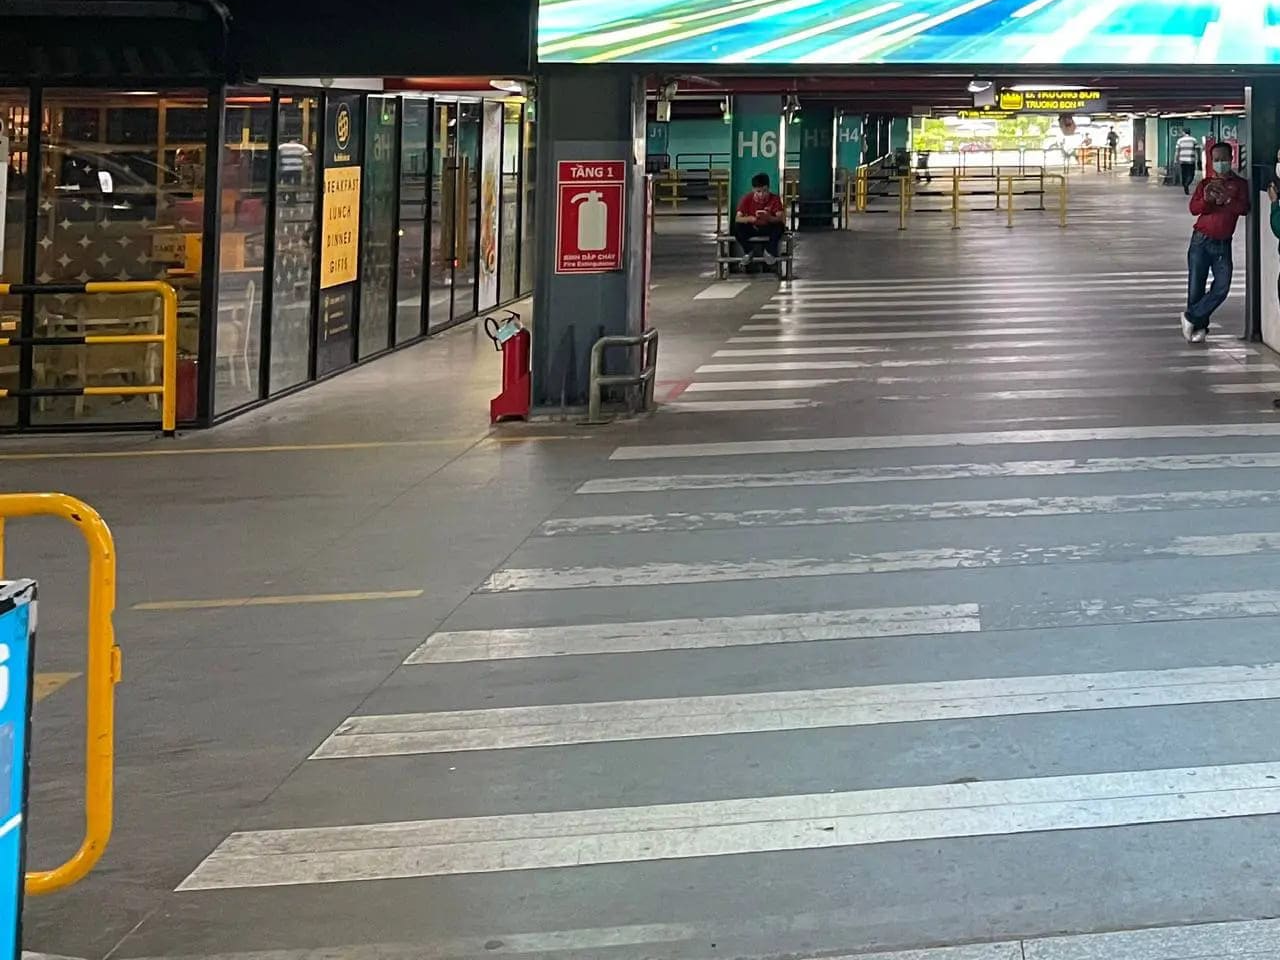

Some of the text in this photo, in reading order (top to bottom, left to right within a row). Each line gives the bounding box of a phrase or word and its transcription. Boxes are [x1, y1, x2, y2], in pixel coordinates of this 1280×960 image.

[838, 127, 859, 142] H4
[1222, 125, 1238, 140] G4
[737, 130, 777, 158] H6
[607, 167, 614, 178] 1
